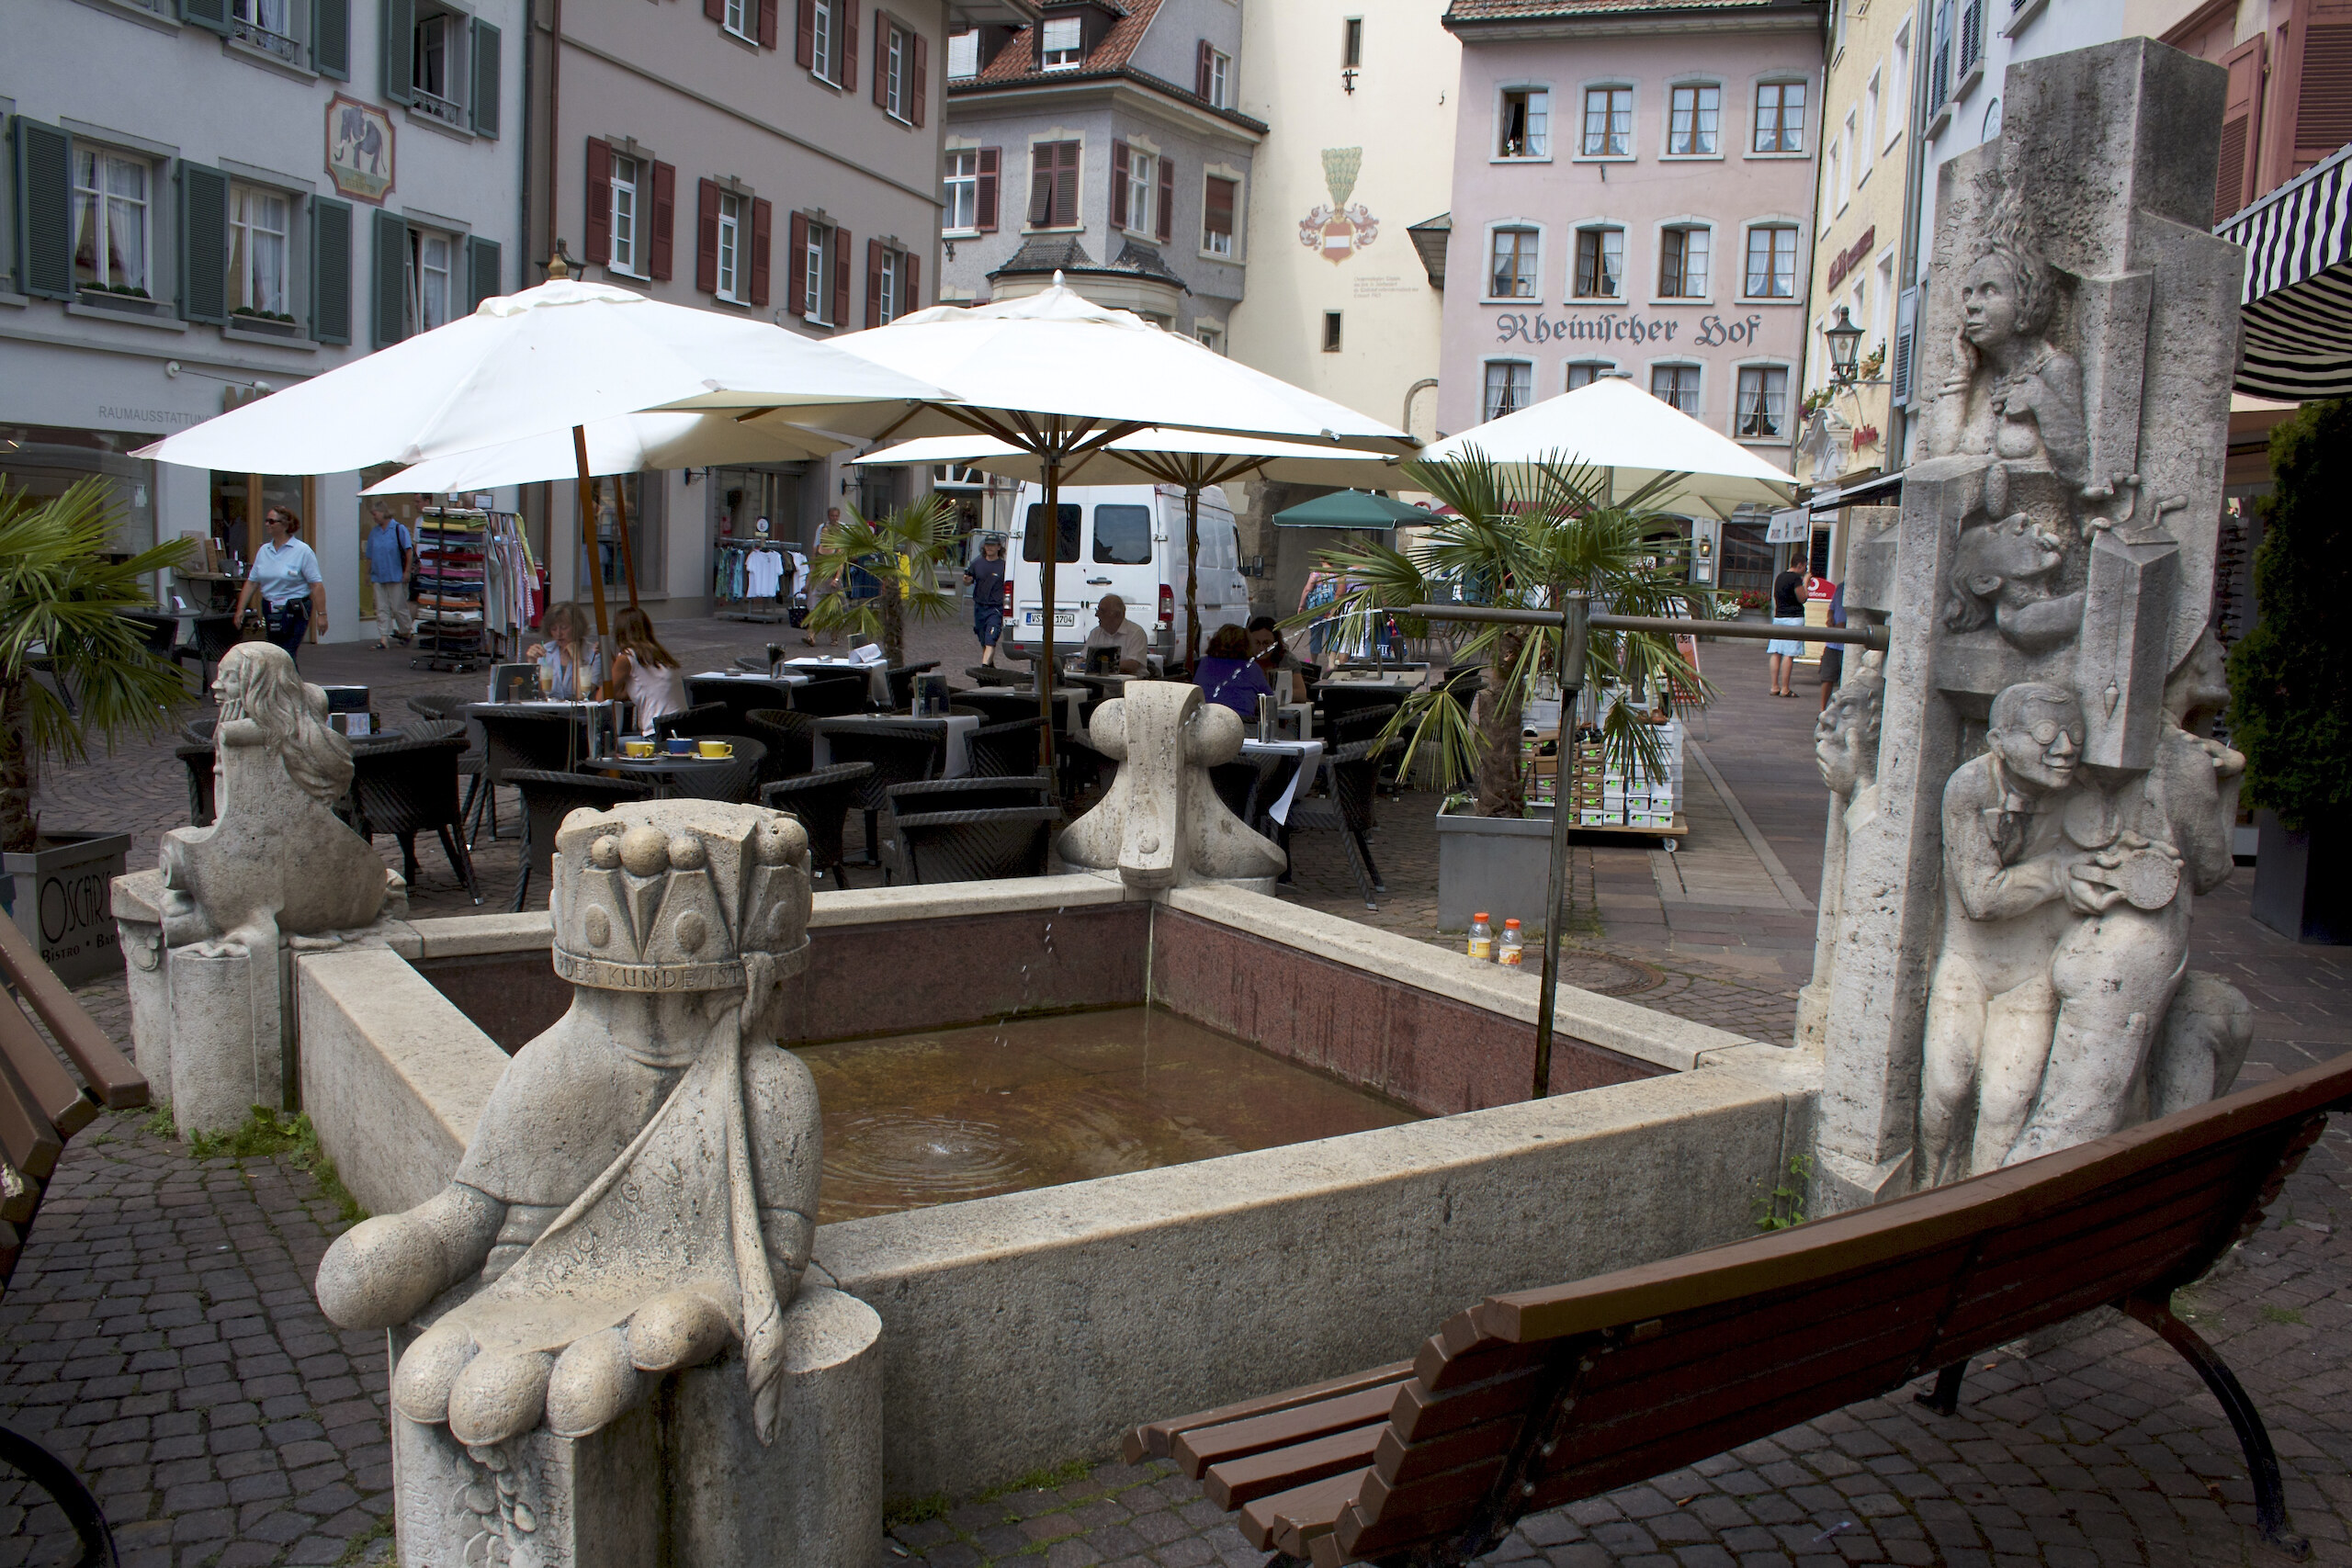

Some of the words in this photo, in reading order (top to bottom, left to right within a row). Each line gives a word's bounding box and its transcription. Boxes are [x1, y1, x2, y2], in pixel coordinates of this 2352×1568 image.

[1693, 313, 1762, 348] Hof
[1055, 615, 1072, 624] 1704
[606, 965, 695, 990] KUNDE
